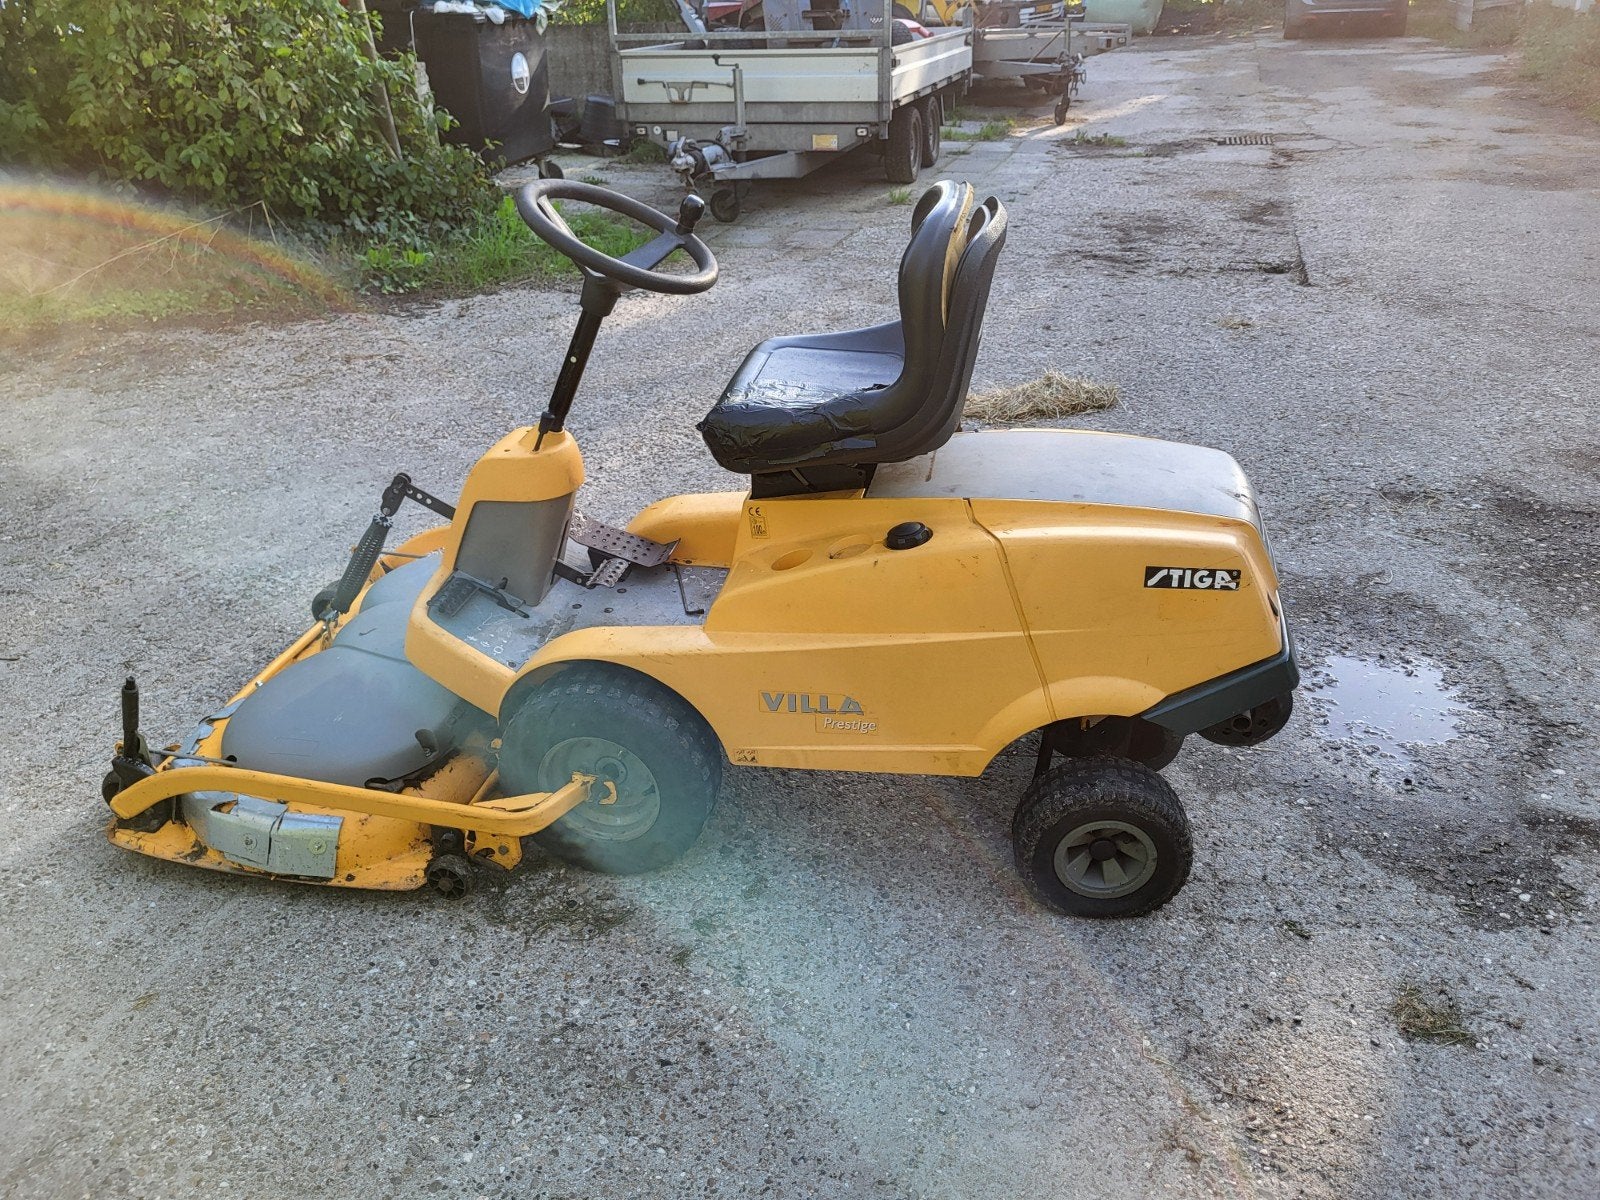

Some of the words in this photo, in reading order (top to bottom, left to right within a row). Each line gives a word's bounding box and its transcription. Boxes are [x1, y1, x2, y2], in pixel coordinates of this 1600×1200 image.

[1147, 568, 1237, 589] STIGA
[760, 691, 864, 716] VILLA
[823, 716, 877, 734] Prestige
